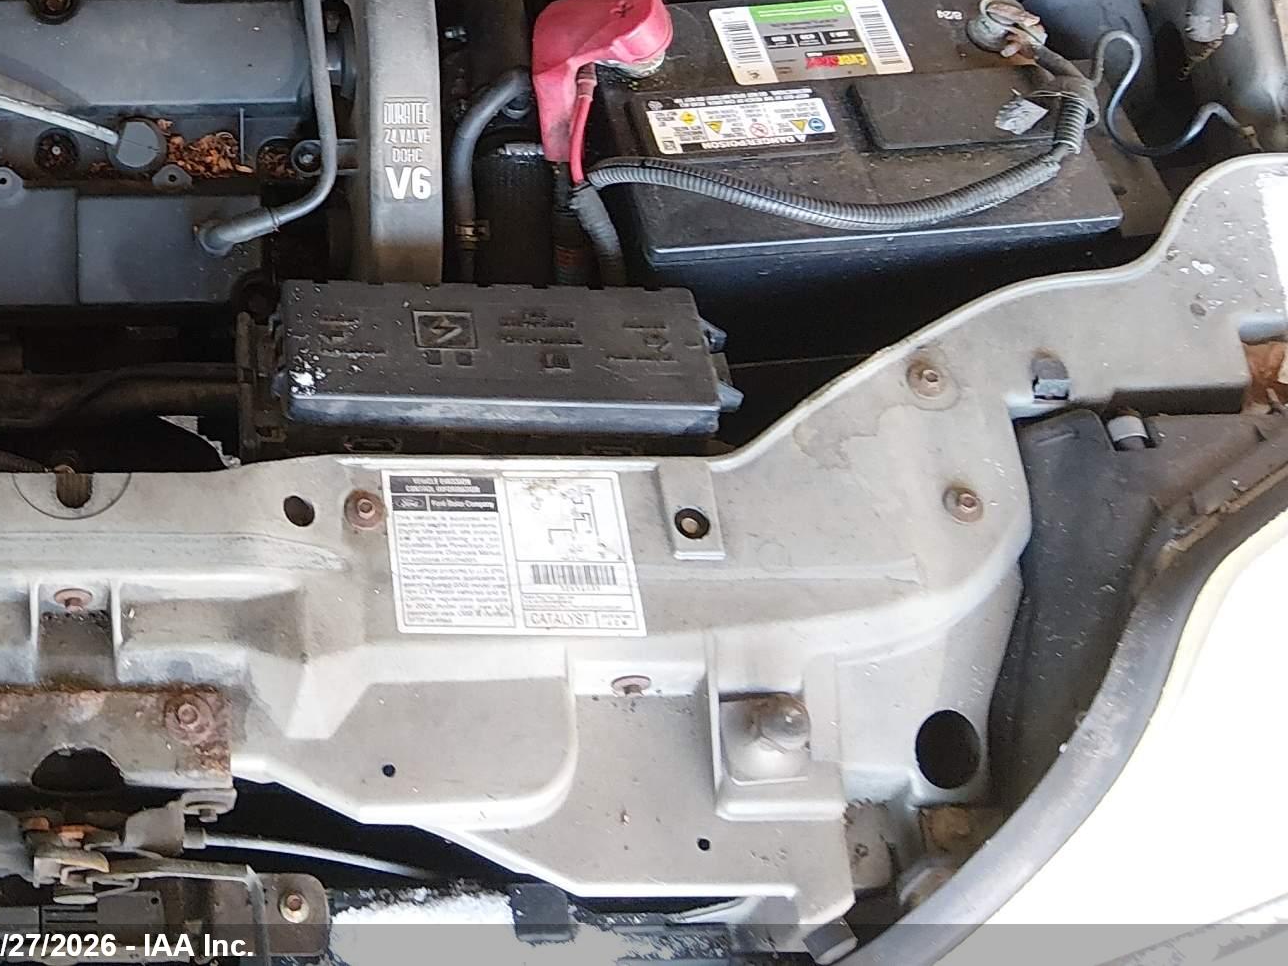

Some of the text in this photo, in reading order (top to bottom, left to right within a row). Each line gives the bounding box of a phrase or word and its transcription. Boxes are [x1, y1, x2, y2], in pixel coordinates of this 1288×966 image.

[383, 102, 432, 125] DURATEC
[384, 128, 432, 144] 24 VALVE
[391, 147, 424, 163] DOHC
[384, 166, 433, 201] V6
[530, 612, 593, 626] CATALYST
